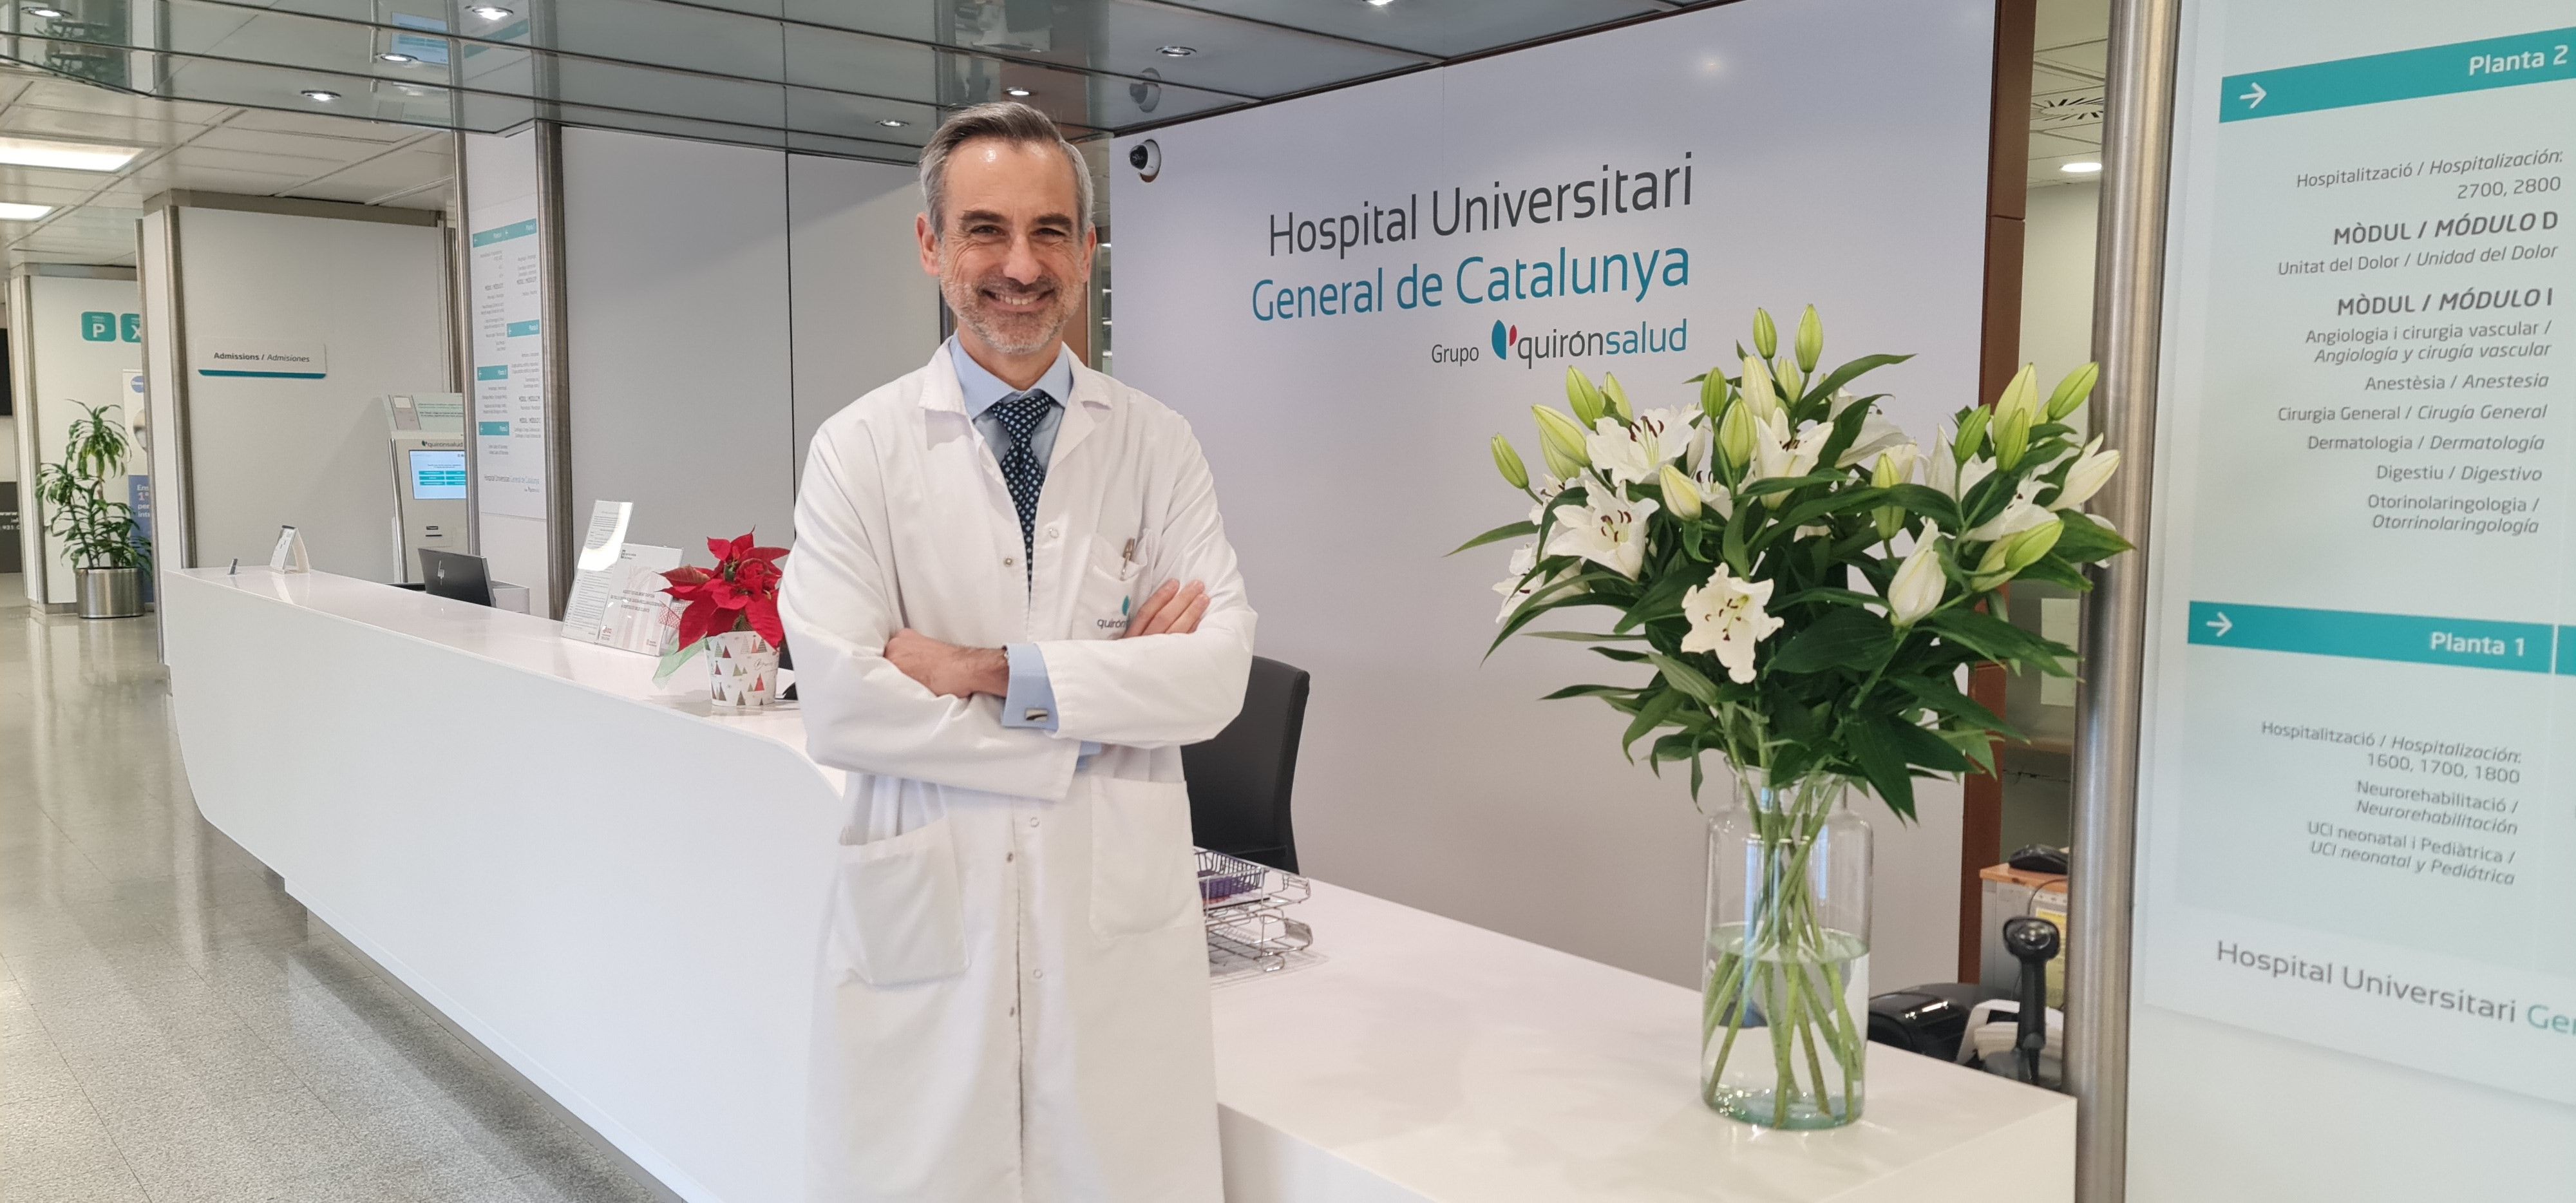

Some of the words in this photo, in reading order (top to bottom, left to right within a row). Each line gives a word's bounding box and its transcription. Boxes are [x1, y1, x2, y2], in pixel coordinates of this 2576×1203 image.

[2469, 51, 2545, 76] Planta
[2553, 44, 2568, 66] 2
[2297, 162, 2413, 188] Hospitalització
[2416, 161, 2425, 176] /
[2457, 181, 2507, 200] 2700,
[2514, 176, 2561, 194] 2800
[1270, 193, 1416, 260] Hospital
[1433, 151, 1692, 236] Universitari
[2333, 222, 2411, 245] MÒDUL
[2417, 221, 2428, 239] /
[2434, 213, 2537, 238] MÓDULO
[2543, 211, 2558, 230] D
[2278, 260, 2325, 276] Unitat
[2329, 257, 2353, 272] del
[2358, 254, 2400, 270] Dolor
[2403, 252, 2412, 267] /
[2417, 248, 2476, 267] Unidad
[2479, 246, 2507, 263] del
[2511, 243, 2559, 261] Dolor
[1252, 267, 1383, 321] General
[1397, 263, 1443, 310] de
[1456, 247, 1689, 304] Catalunya
[2338, 293, 2416, 316] MÒDUL
[2421, 294, 2432, 312] /
[2438, 287, 2541, 311] MÓDULO
[2546, 287, 2553, 306] I
[92, 323, 105, 337] P
[2305, 328, 2388, 346] Angiologia
[2393, 326, 2398, 341] i
[2402, 323, 2463, 342] cirurgia
[2469, 321, 2539, 337] vascular
[2544, 319, 2552, 335] /
[214, 352, 259, 361] Admissions
[267, 354, 310, 363] Admisiones
[1432, 344, 1479, 367] Grupo
[1517, 318, 1687, 370] quirónsalud
[2313, 346, 2398, 366] Angiología
[2401, 348, 2414, 364] y
[2418, 343, 2474, 363] cirugía
[2480, 341, 2552, 358] vascular
[2364, 375, 2445, 391] Anestèsia
[2450, 375, 2458, 389] /
[2461, 372, 2550, 389] Anestesia
[2278, 406, 2336, 424] Cirurgia
[2340, 406, 2401, 421] General
[2405, 405, 2412, 420] /
[2418, 404, 2475, 423] Cirugía
[2480, 404, 2548, 419] General
[2307, 435, 2413, 453] Dermatologia
[2417, 435, 2425, 450] /
[2430, 434, 2545, 453] Dermatología
[2376, 464, 2444, 483] Digestiu
[2448, 466, 2456, 480] /
[2461, 466, 2543, 484] Digestivo
[2368, 494, 2527, 515] Otorinolaringologia
[2531, 497, 2540, 512] /
[2372, 514, 2539, 536] Otorrinolaringología
[2430, 631, 2505, 655] Planta
[2515, 638, 2524, 657] 1
[2261, 721, 2376, 748] Hospitalització
[2379, 734, 2387, 748] /
[2367, 753, 2413, 772] 1600,
[2421, 759, 2468, 779] 1700,
[2476, 765, 2520, 784] 1800
[2356, 780, 2506, 813] Neurorehabilitació
[2511, 800, 2519, 814] /
[2356, 799, 2519, 836] Neurorehabilitación
[2308, 820, 2333, 837] UCI
[2338, 828, 2407, 848] neonatal
[2412, 836, 2416, 850] i
[2421, 837, 2503, 864] Pediàtrica
[2508, 851, 2516, 864] /
[2311, 840, 2337, 857] UCI
[2340, 848, 2412, 869] neonatal
[2414, 860, 2427, 874] y
[2430, 858, 2515, 886] Pediátrica
[2217, 940, 2333, 985] Hospital
[2343, 966, 2516, 1023] Universitari
